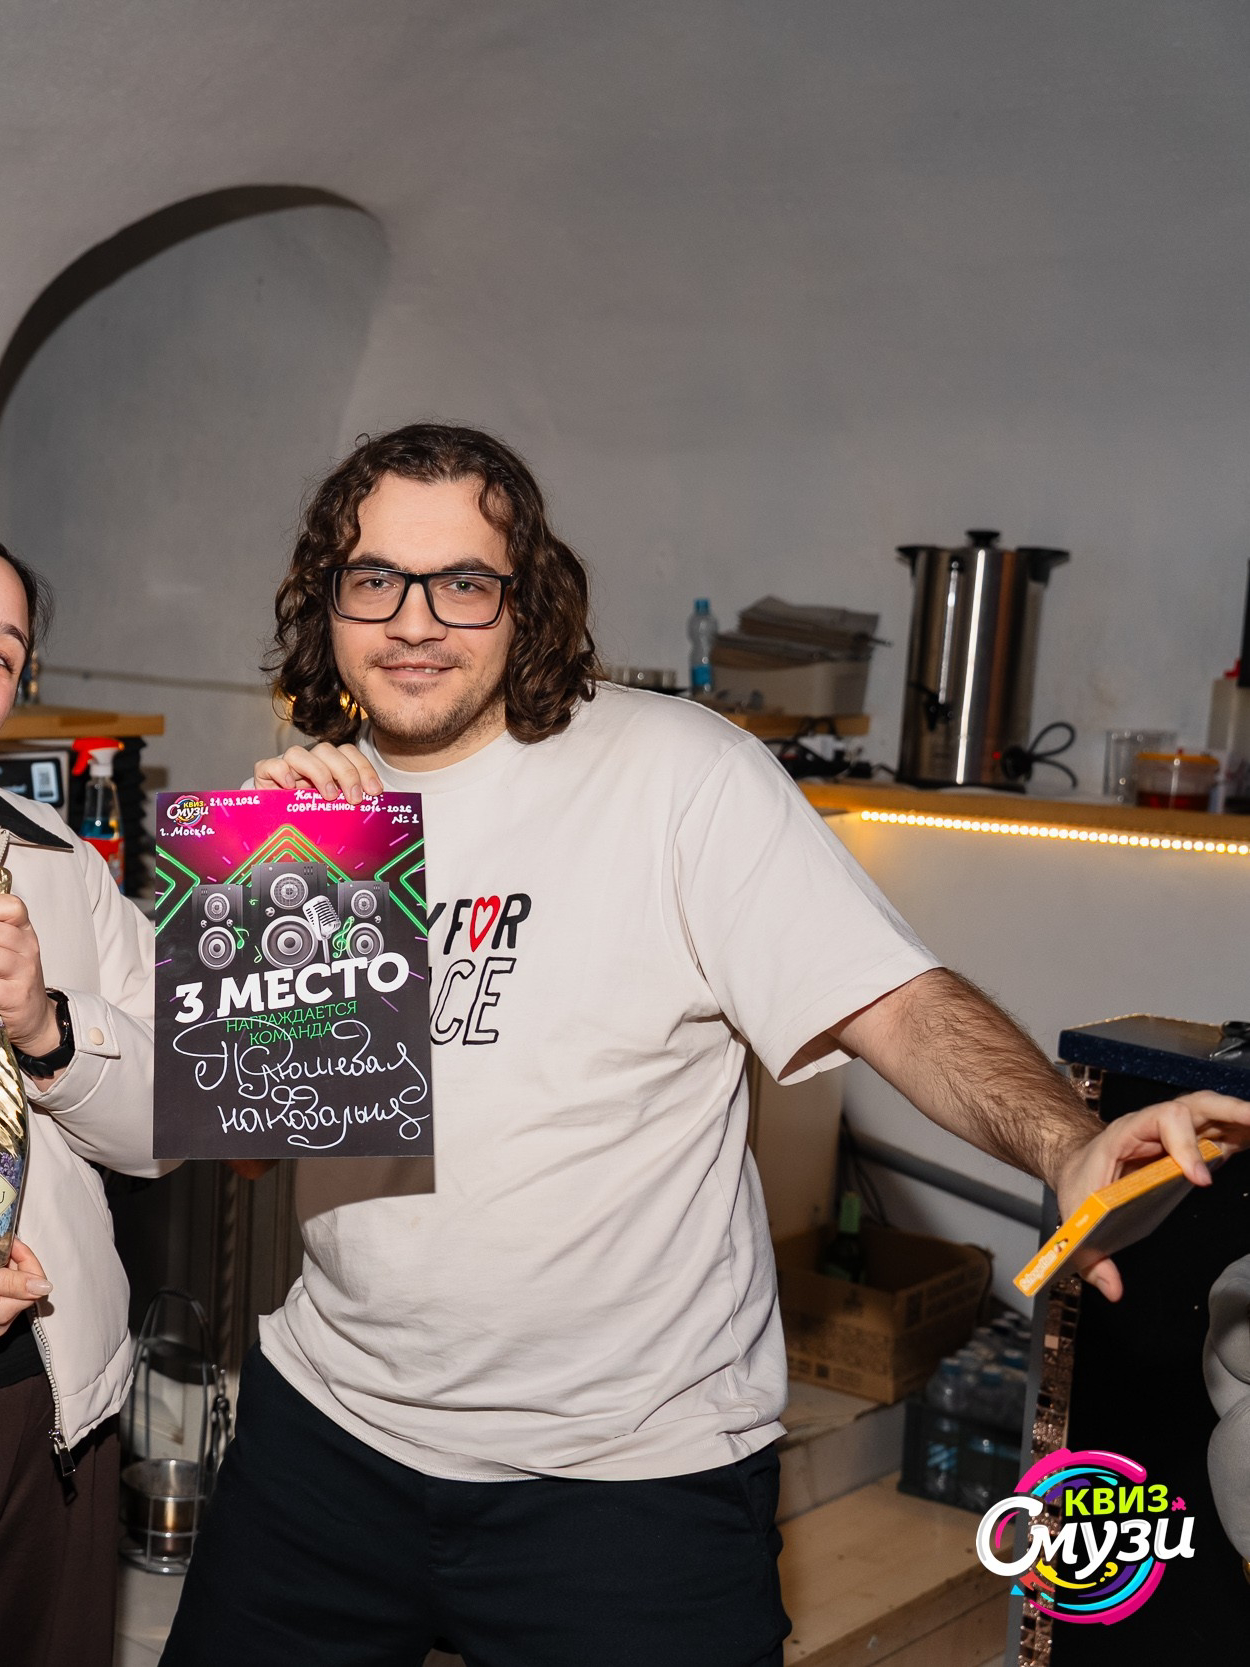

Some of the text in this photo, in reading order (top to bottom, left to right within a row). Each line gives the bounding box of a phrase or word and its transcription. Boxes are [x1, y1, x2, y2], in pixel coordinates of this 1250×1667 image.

[166, 803, 209, 819] Смузи
[183, 800, 204, 808] КВИЗ
[170, 824, 216, 838] Москва
[174, 952, 410, 1023] 3 МЕСТО
[226, 1000, 358, 1033] НАГРАЖДАЕТСЯ
[249, 1021, 334, 1046] КОМАНДА
[173, 1017, 428, 1104] Плюшевая
[217, 1085, 431, 1149] наковальня
